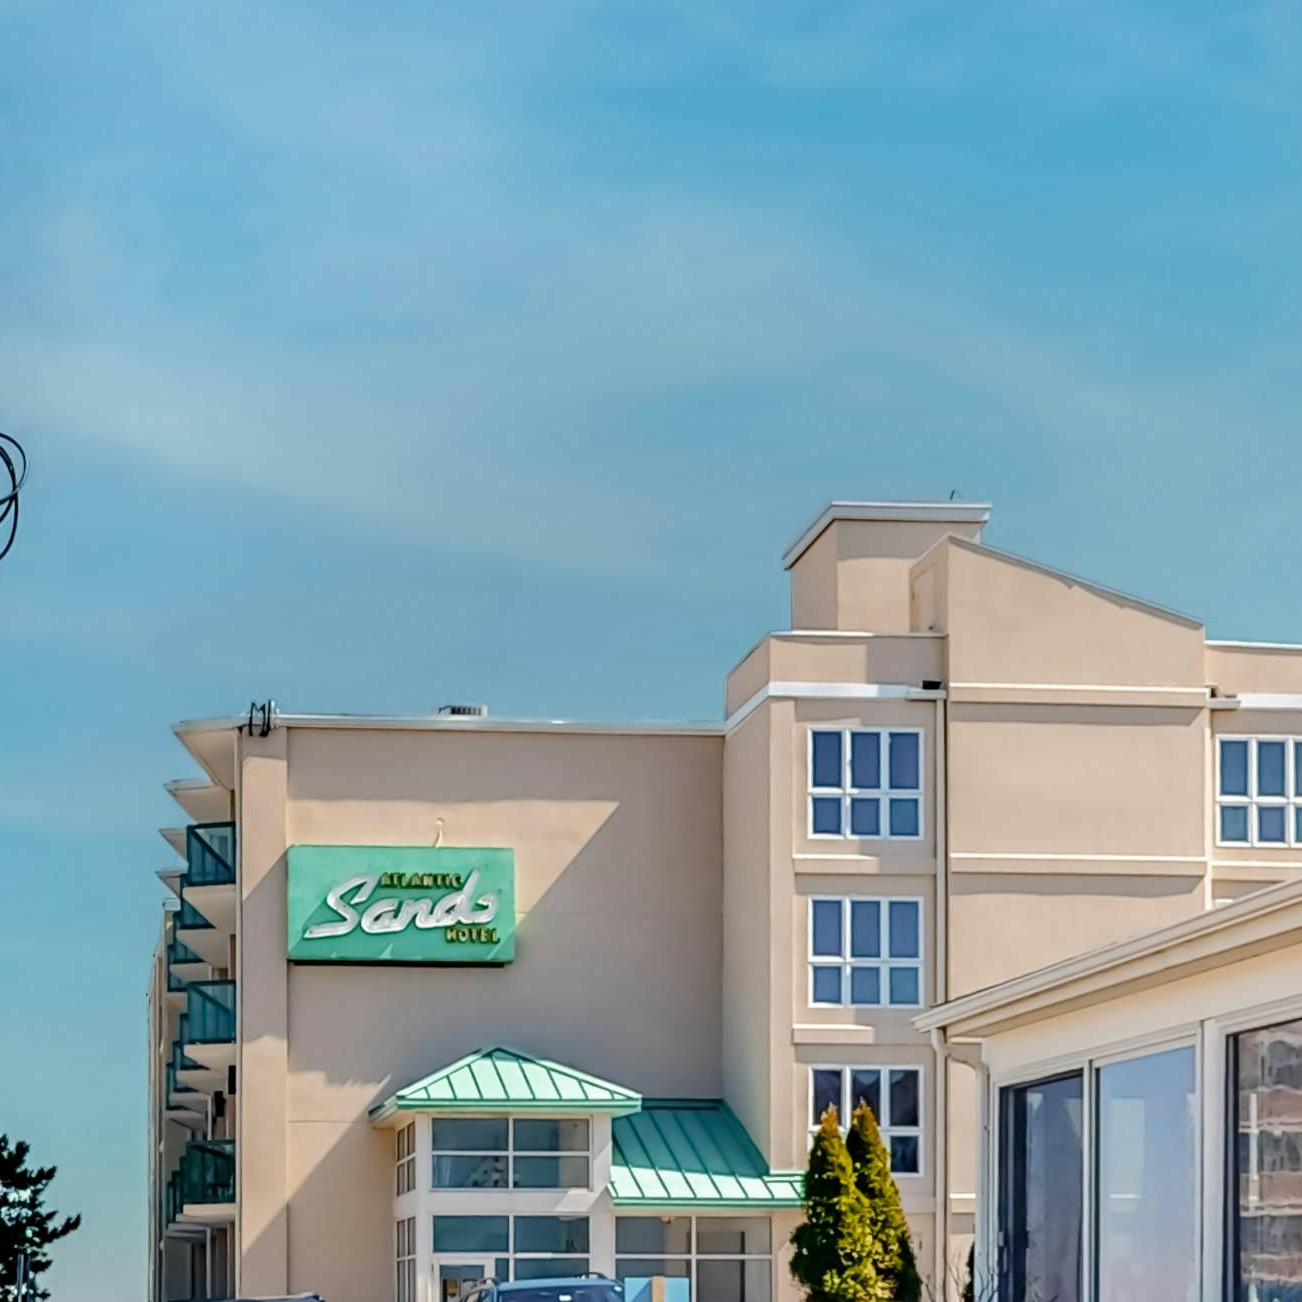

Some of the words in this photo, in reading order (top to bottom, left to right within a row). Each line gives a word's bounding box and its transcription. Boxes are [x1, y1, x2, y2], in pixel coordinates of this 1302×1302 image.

[379, 872, 462, 889] ATLANTIC
[303, 868, 497, 939] Sands
[446, 926, 501, 944] HOTEL
